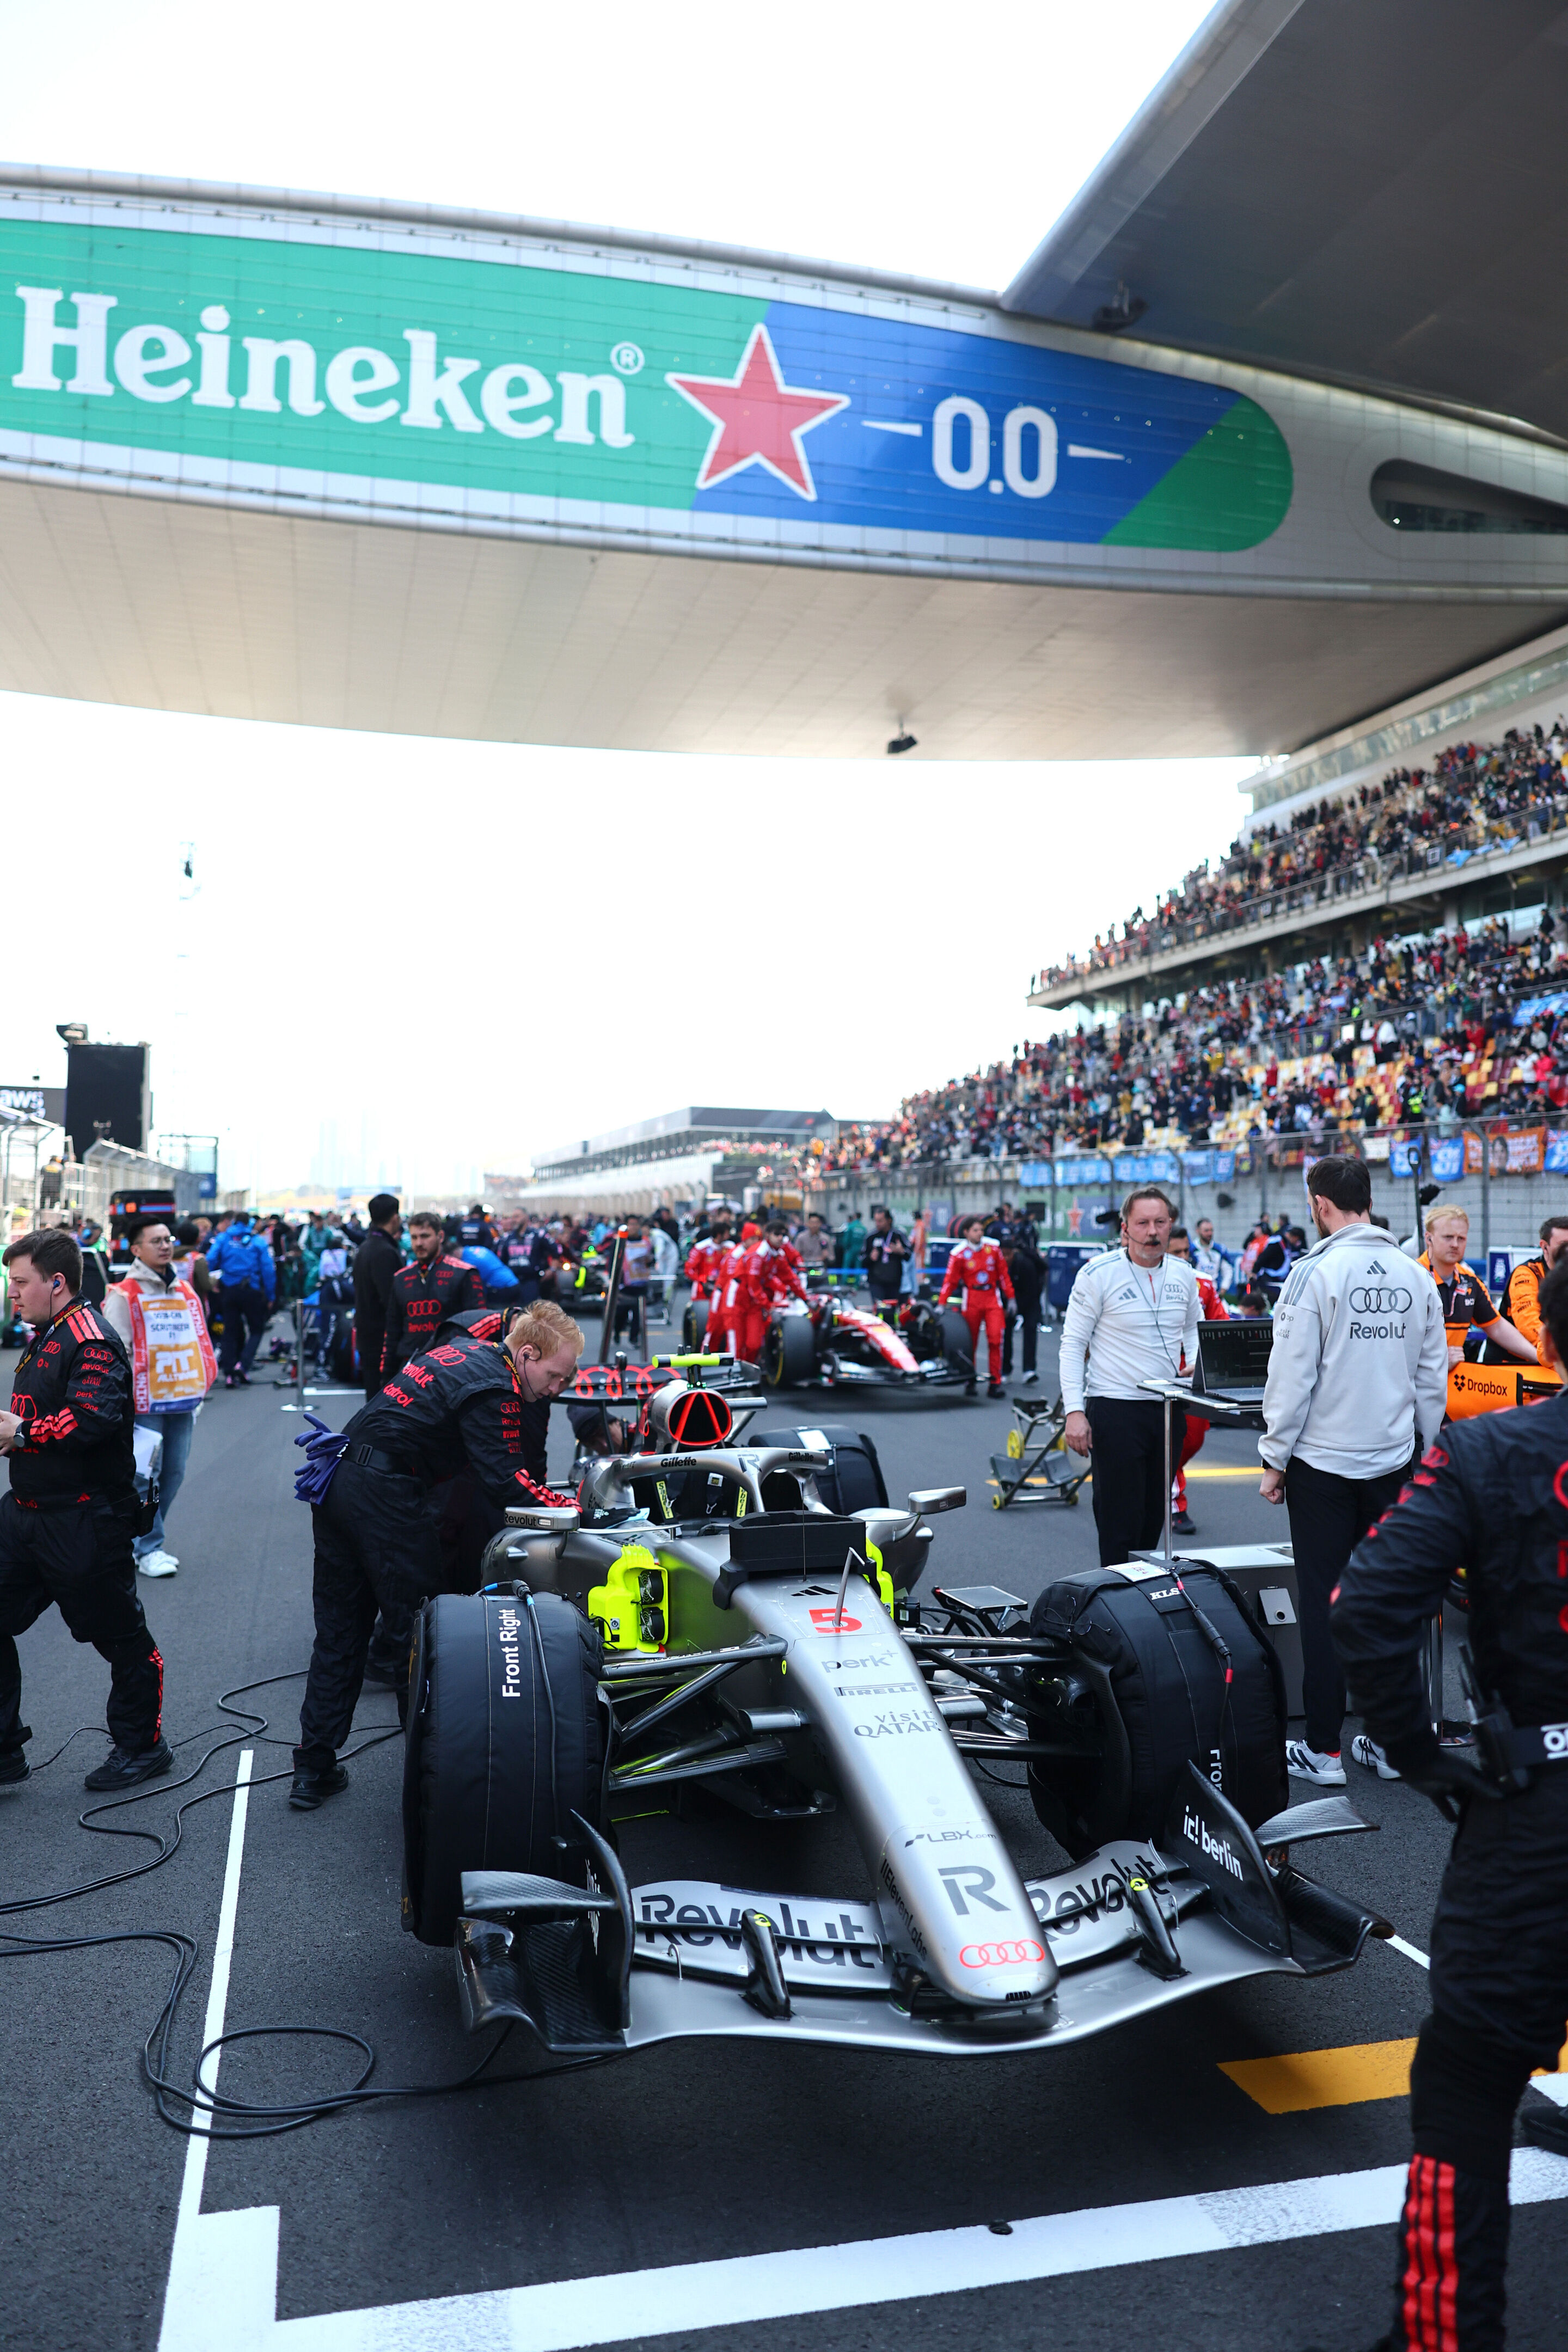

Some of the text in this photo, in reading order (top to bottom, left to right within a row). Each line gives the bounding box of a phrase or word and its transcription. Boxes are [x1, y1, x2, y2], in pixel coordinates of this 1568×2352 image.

[11, 285, 635, 449] Heineken
[932, 395, 1058, 499] 0.0
[1350, 1322, 1406, 1339] Revolut
[81, 1363, 109, 1374] Revolut
[402, 1363, 434, 1388] evolut
[1468, 1379, 1508, 1396] Dropbox
[660, 1456, 697, 1468] Gillette
[788, 1452, 814, 1462] Gillette
[739, 1489, 747, 1517] belt
[505, 1513, 537, 1527] Revolut
[808, 1608, 862, 1633] 5
[499, 1609, 521, 1697] Front Right
[834, 1682, 919, 1696] PIRELLI
[874, 1709, 935, 1723] visit
[854, 1720, 942, 1738] QATAR
[1202, 1820, 1244, 1882] berlin
[937, 1865, 1011, 1916] R
[641, 1894, 875, 1969] Revlut
